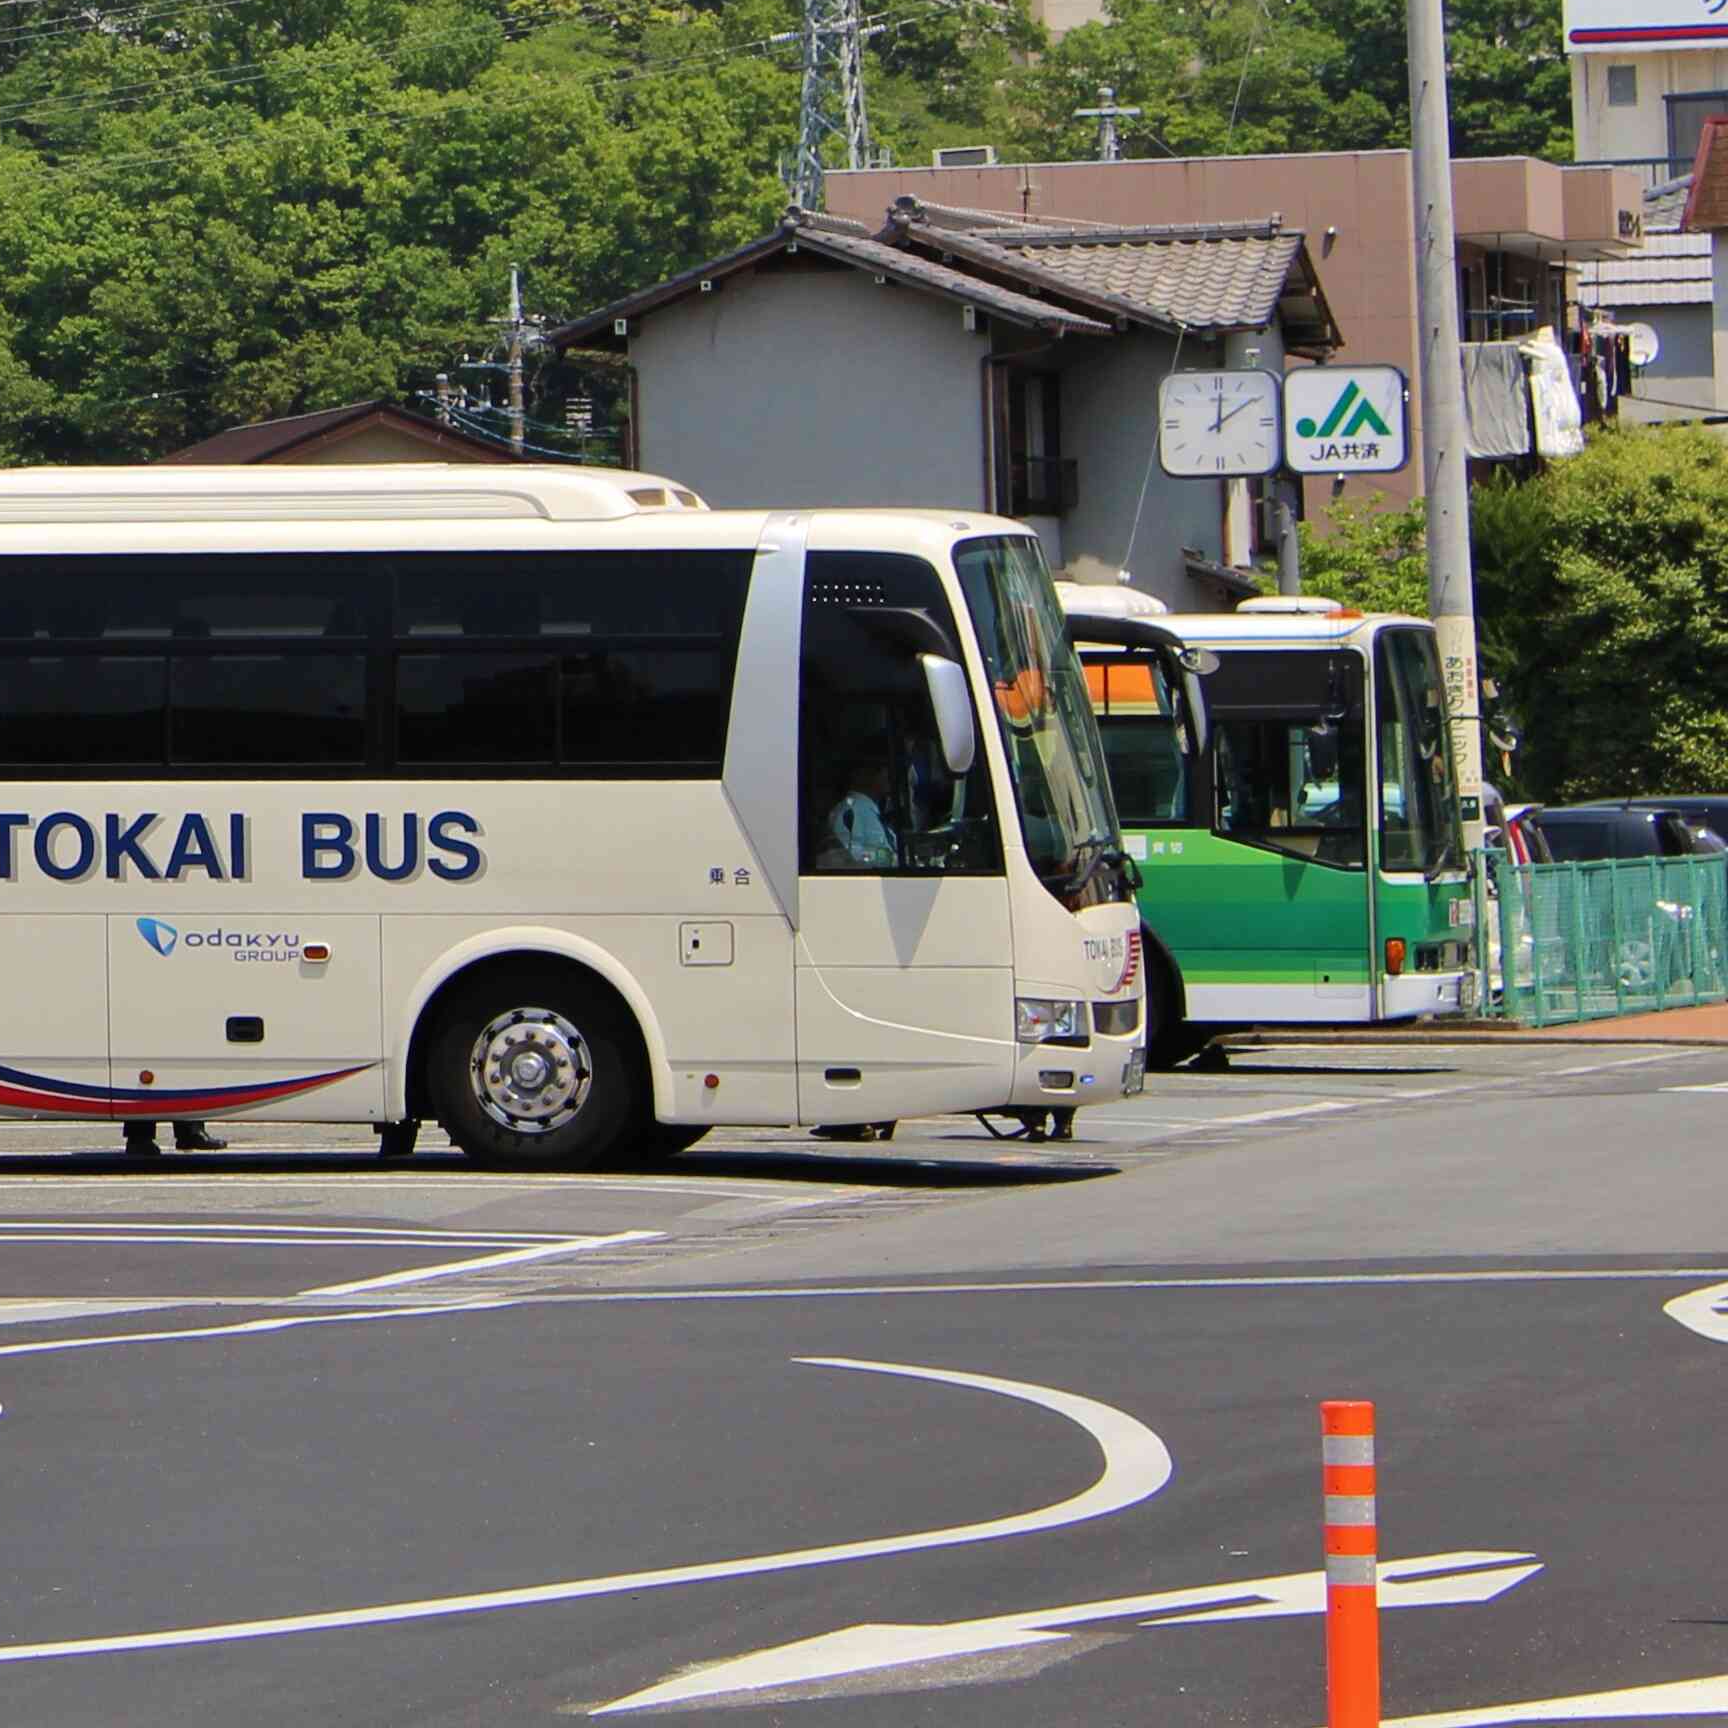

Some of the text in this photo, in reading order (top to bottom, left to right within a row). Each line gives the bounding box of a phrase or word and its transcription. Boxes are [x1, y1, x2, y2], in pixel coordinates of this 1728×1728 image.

[1310, 441, 1380, 461] JA共済
[302, 811, 483, 881] BUS
[185, 928, 300, 948] odakyu
[234, 950, 300, 962] GROUP
